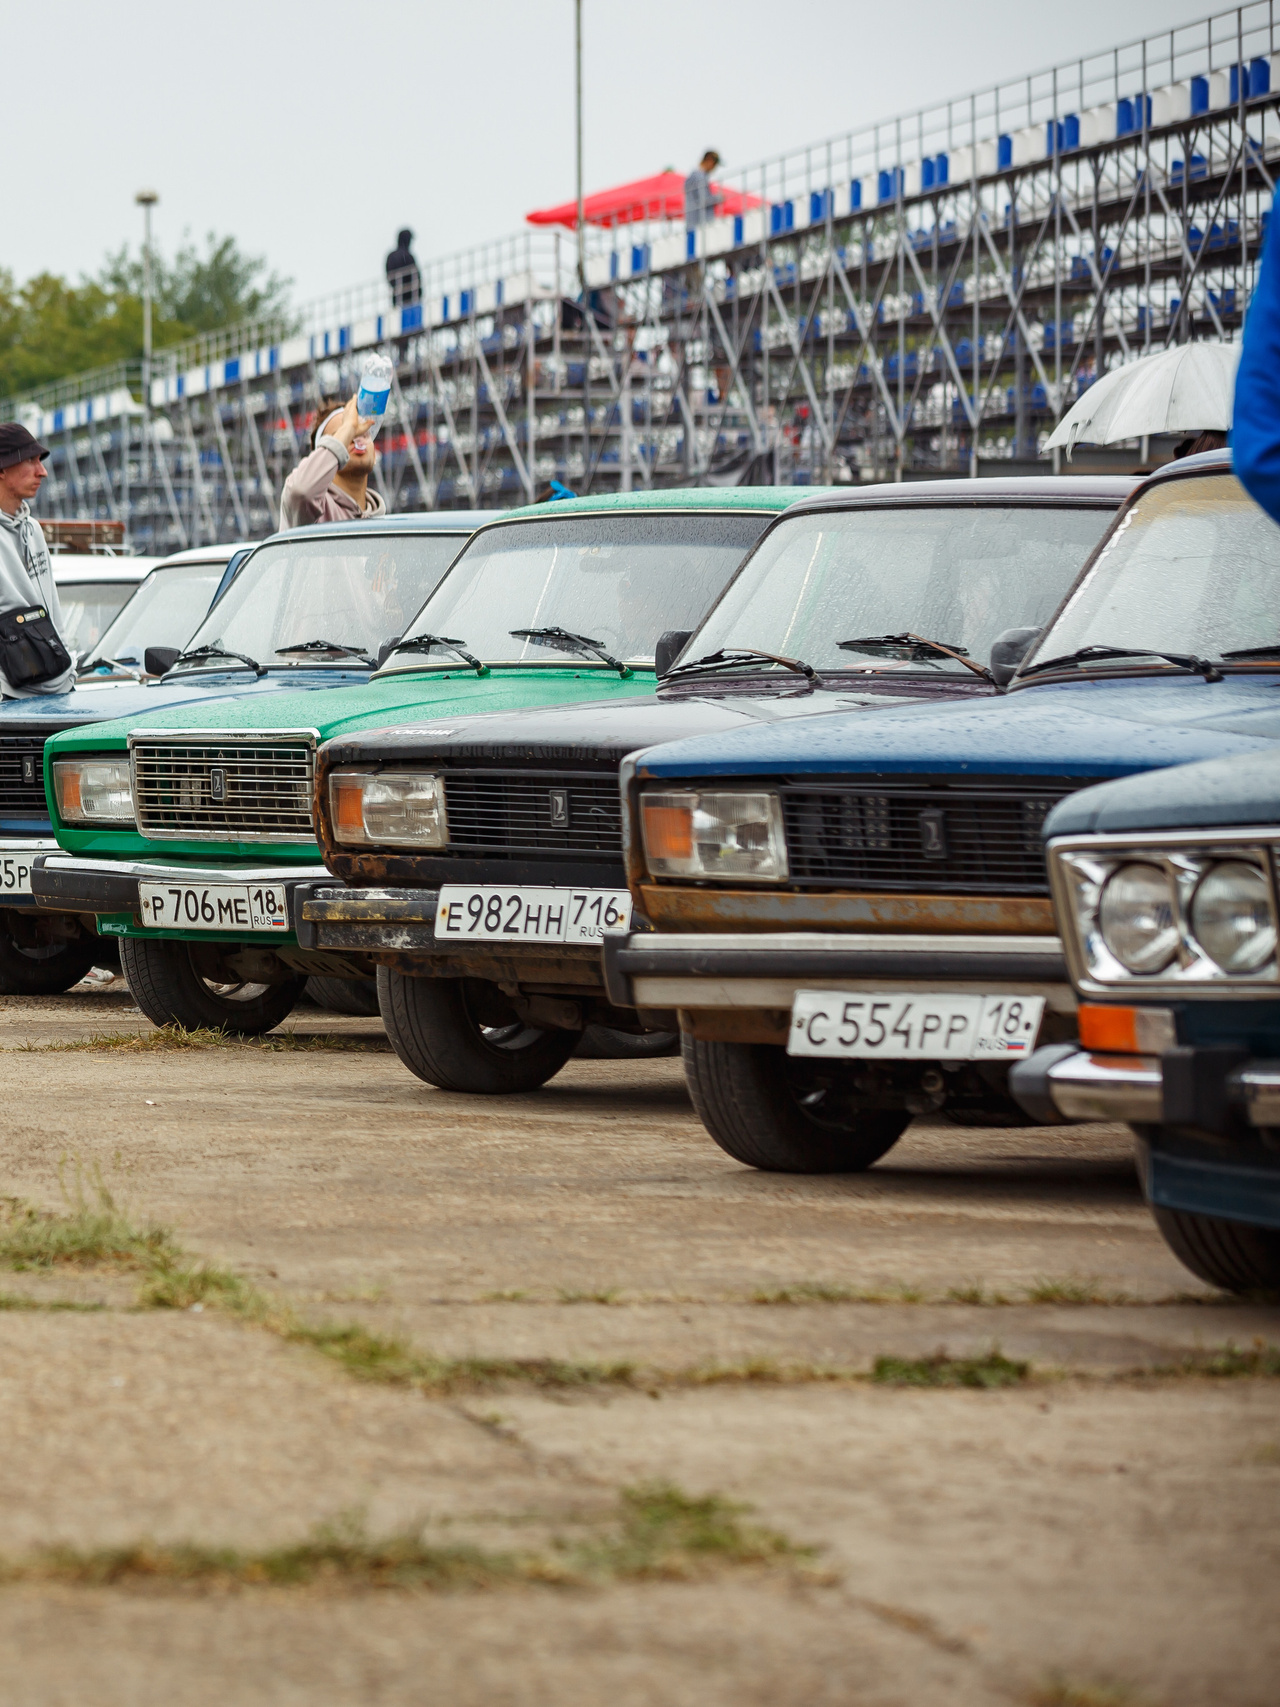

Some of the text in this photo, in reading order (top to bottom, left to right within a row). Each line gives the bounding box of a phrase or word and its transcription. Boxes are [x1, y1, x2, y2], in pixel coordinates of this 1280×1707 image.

[253, 889, 278, 915] 18
[253, 915, 272, 926] RUS
[446, 894, 619, 935] Е982НН 716
[580, 926, 605, 938] RUS
[987, 1002, 1023, 1035] 18
[976, 1037, 1008, 1051] RUS
